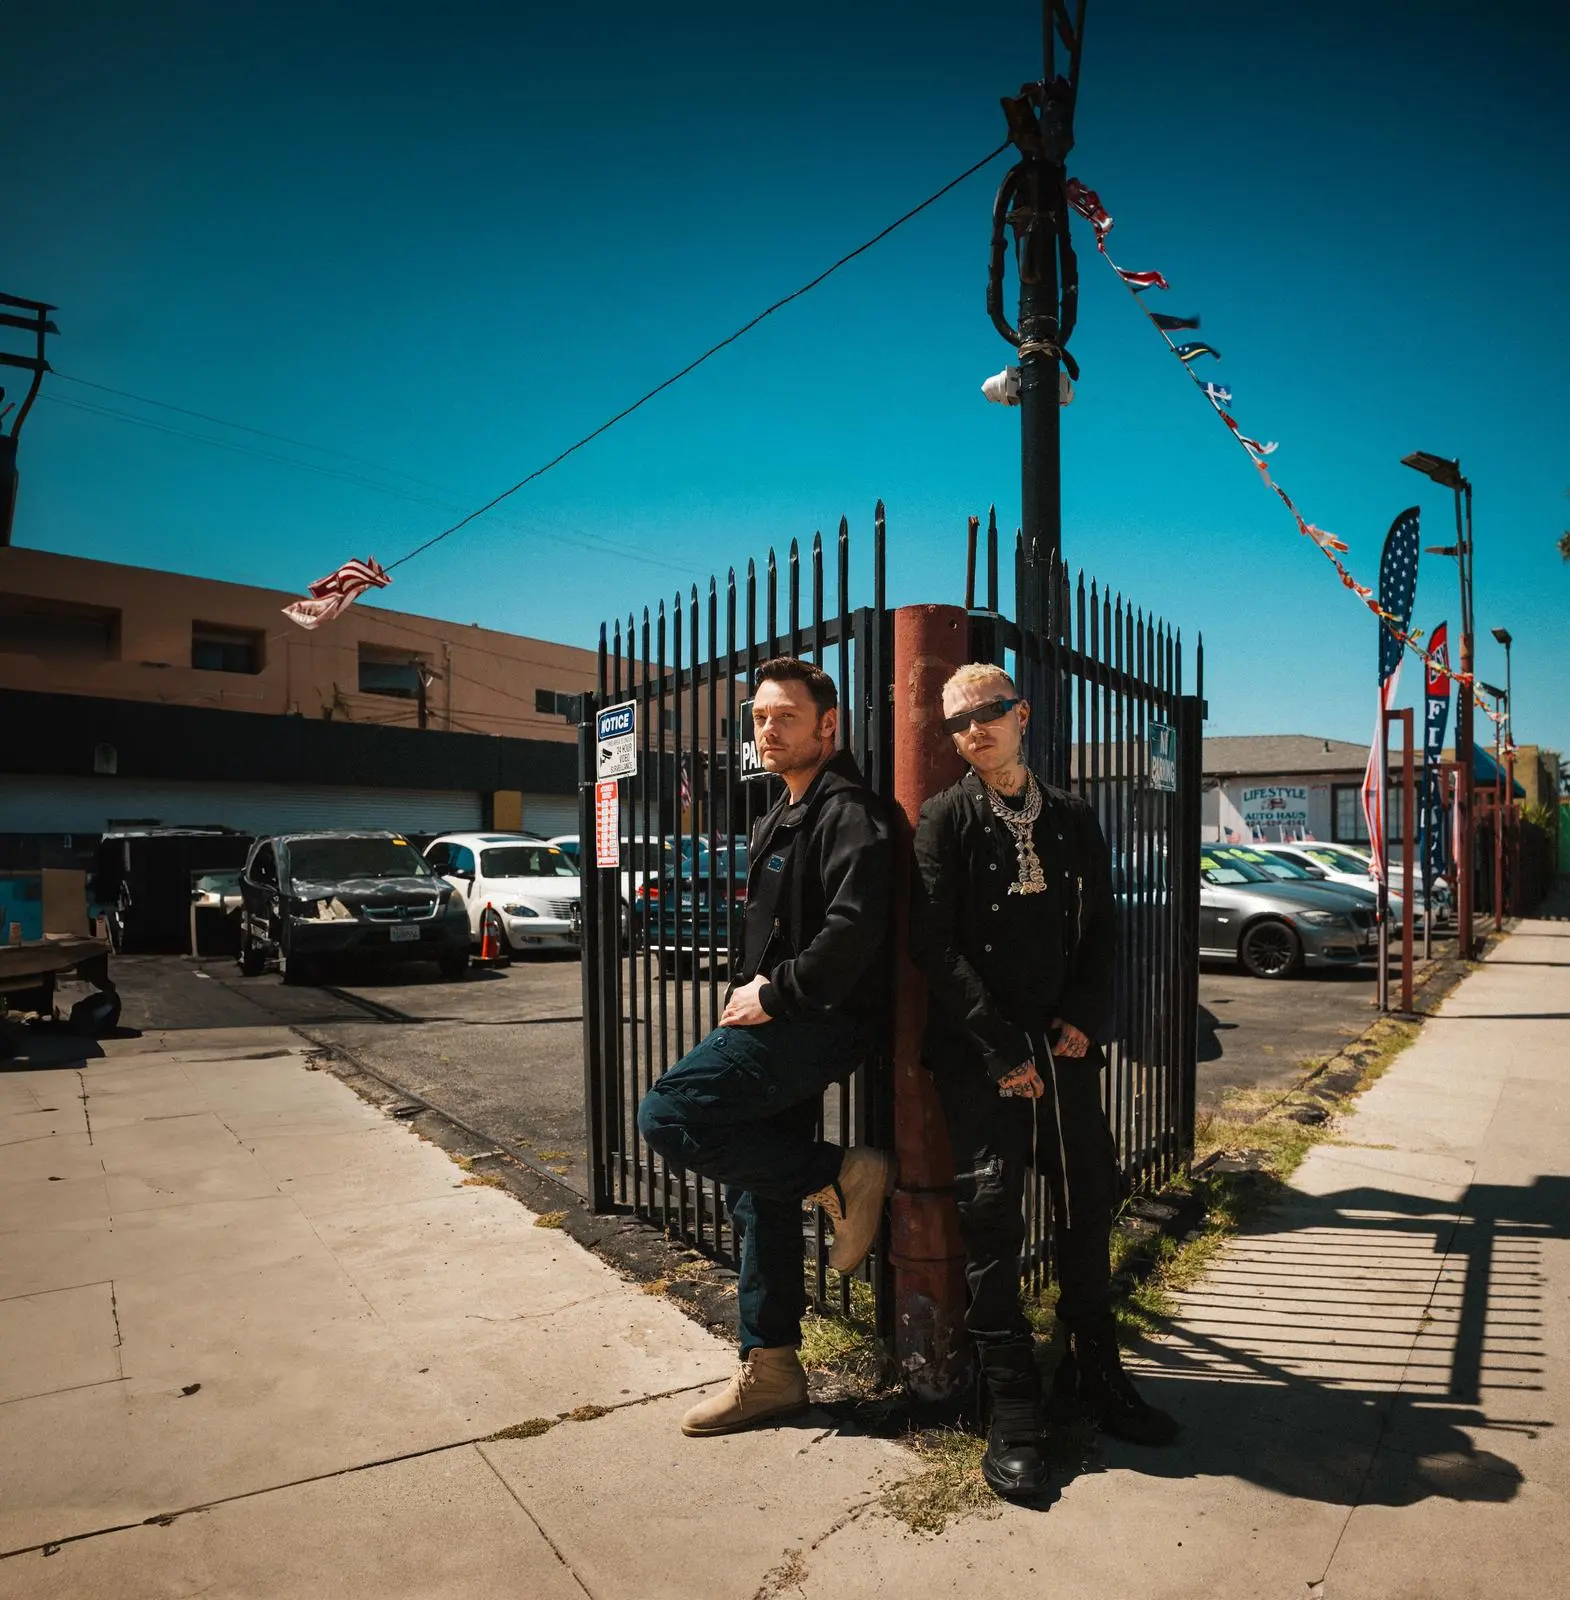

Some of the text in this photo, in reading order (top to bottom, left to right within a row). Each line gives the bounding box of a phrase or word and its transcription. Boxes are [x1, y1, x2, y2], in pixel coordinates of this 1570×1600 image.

[601, 713, 630, 734] NOTICE
[1243, 787, 1306, 802] LIFESTYLE
[1245, 811, 1306, 820] AUTO HAUS
